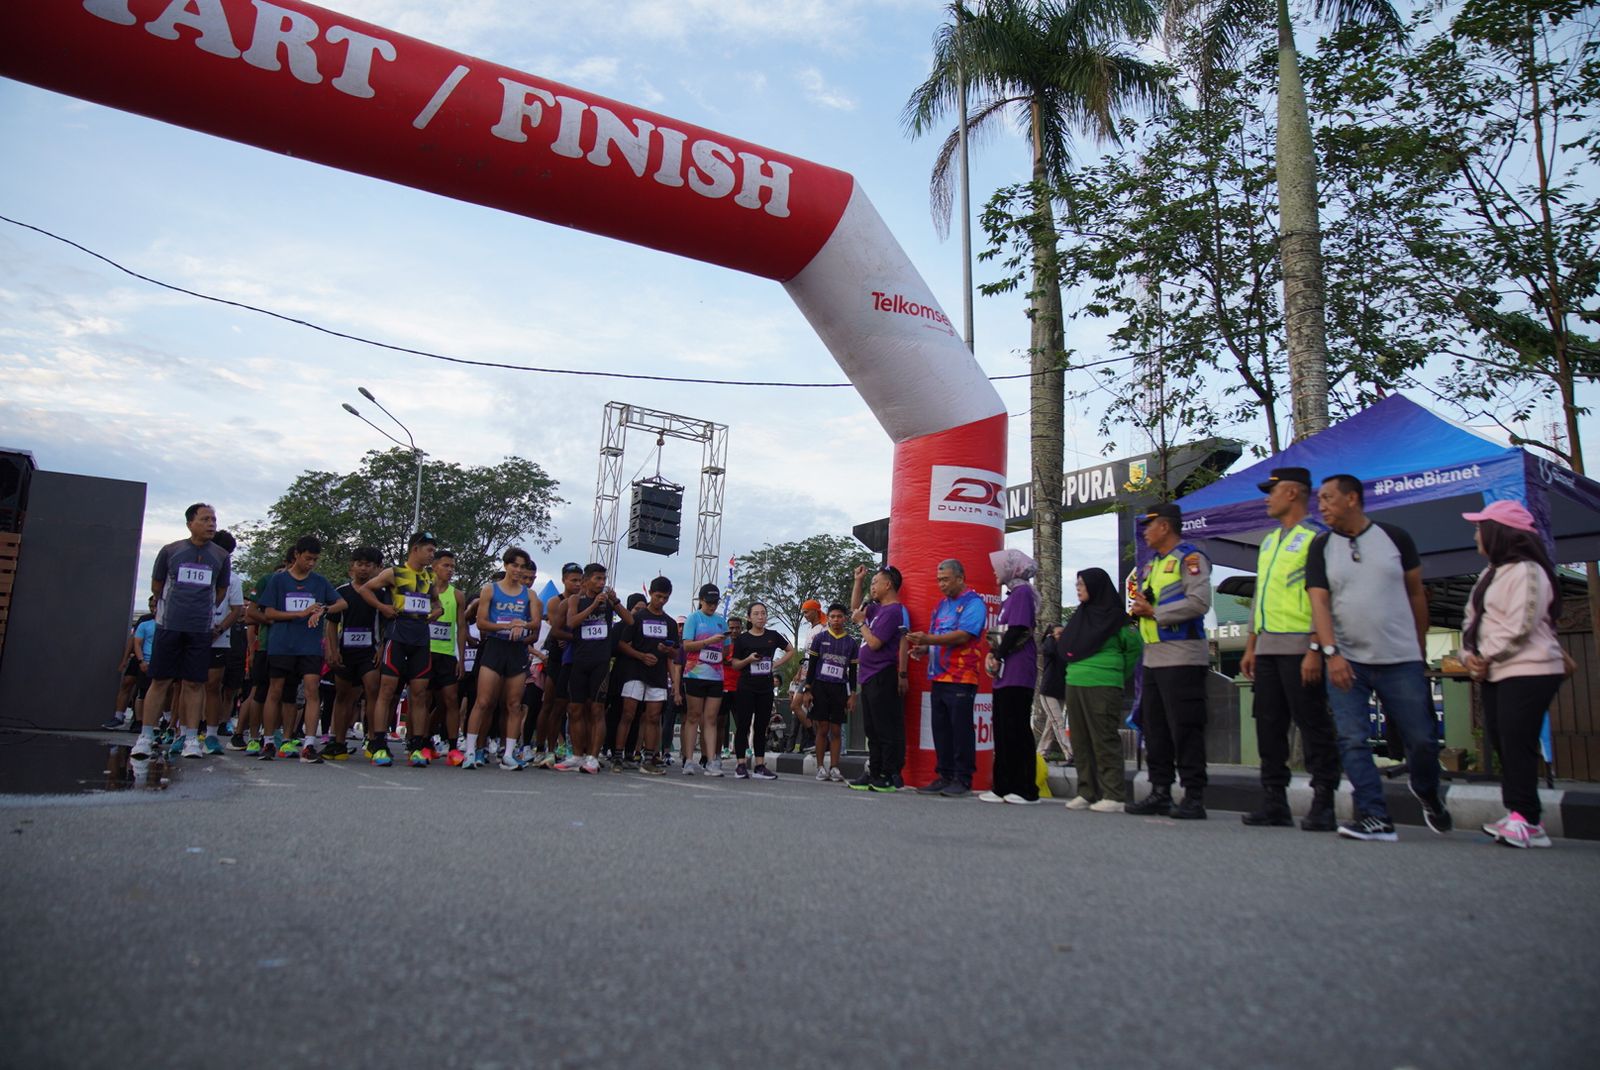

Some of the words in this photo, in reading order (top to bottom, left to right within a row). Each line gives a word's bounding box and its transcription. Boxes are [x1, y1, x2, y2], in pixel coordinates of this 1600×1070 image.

[490, 77, 793, 218] FINISH
[1374, 464, 1480, 495] #PakeBiznet
[186, 570, 204, 581] 116
[293, 599, 309, 609] 177
[411, 599, 426, 609] 170
[434, 627, 448, 636] 212
[587, 627, 602, 636] 134
[649, 625, 662, 634] 185
[350, 634, 366, 643] 227
[757, 662, 770, 671] 108
